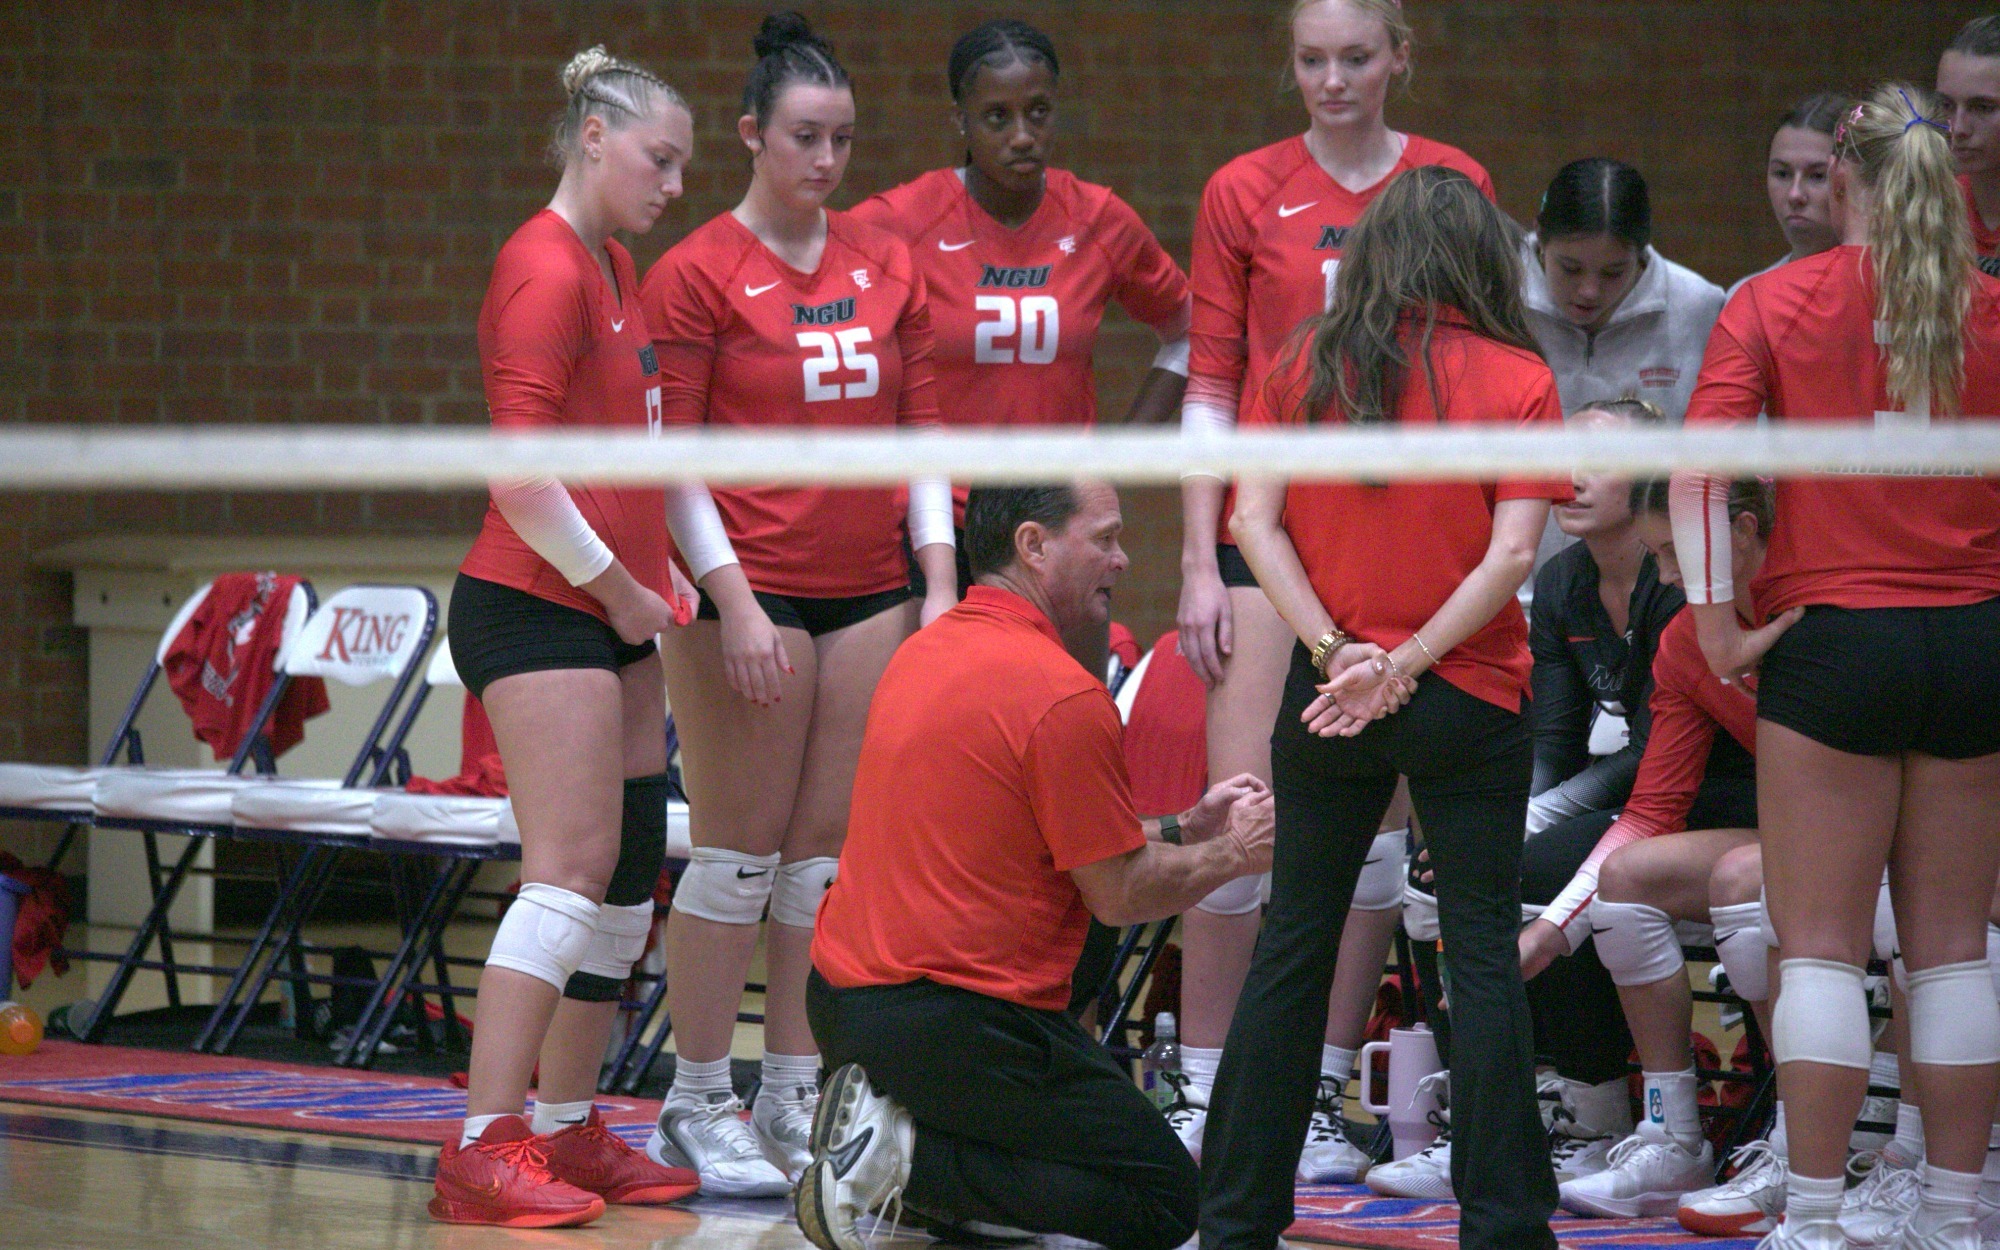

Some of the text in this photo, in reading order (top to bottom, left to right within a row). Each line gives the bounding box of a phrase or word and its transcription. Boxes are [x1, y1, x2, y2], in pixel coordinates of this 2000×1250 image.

[977, 263, 1053, 288] NGU
[791, 297, 856, 326] NGU
[975, 294, 1059, 364] 20
[796, 327, 879, 402] 25
[315, 607, 410, 664] KING
